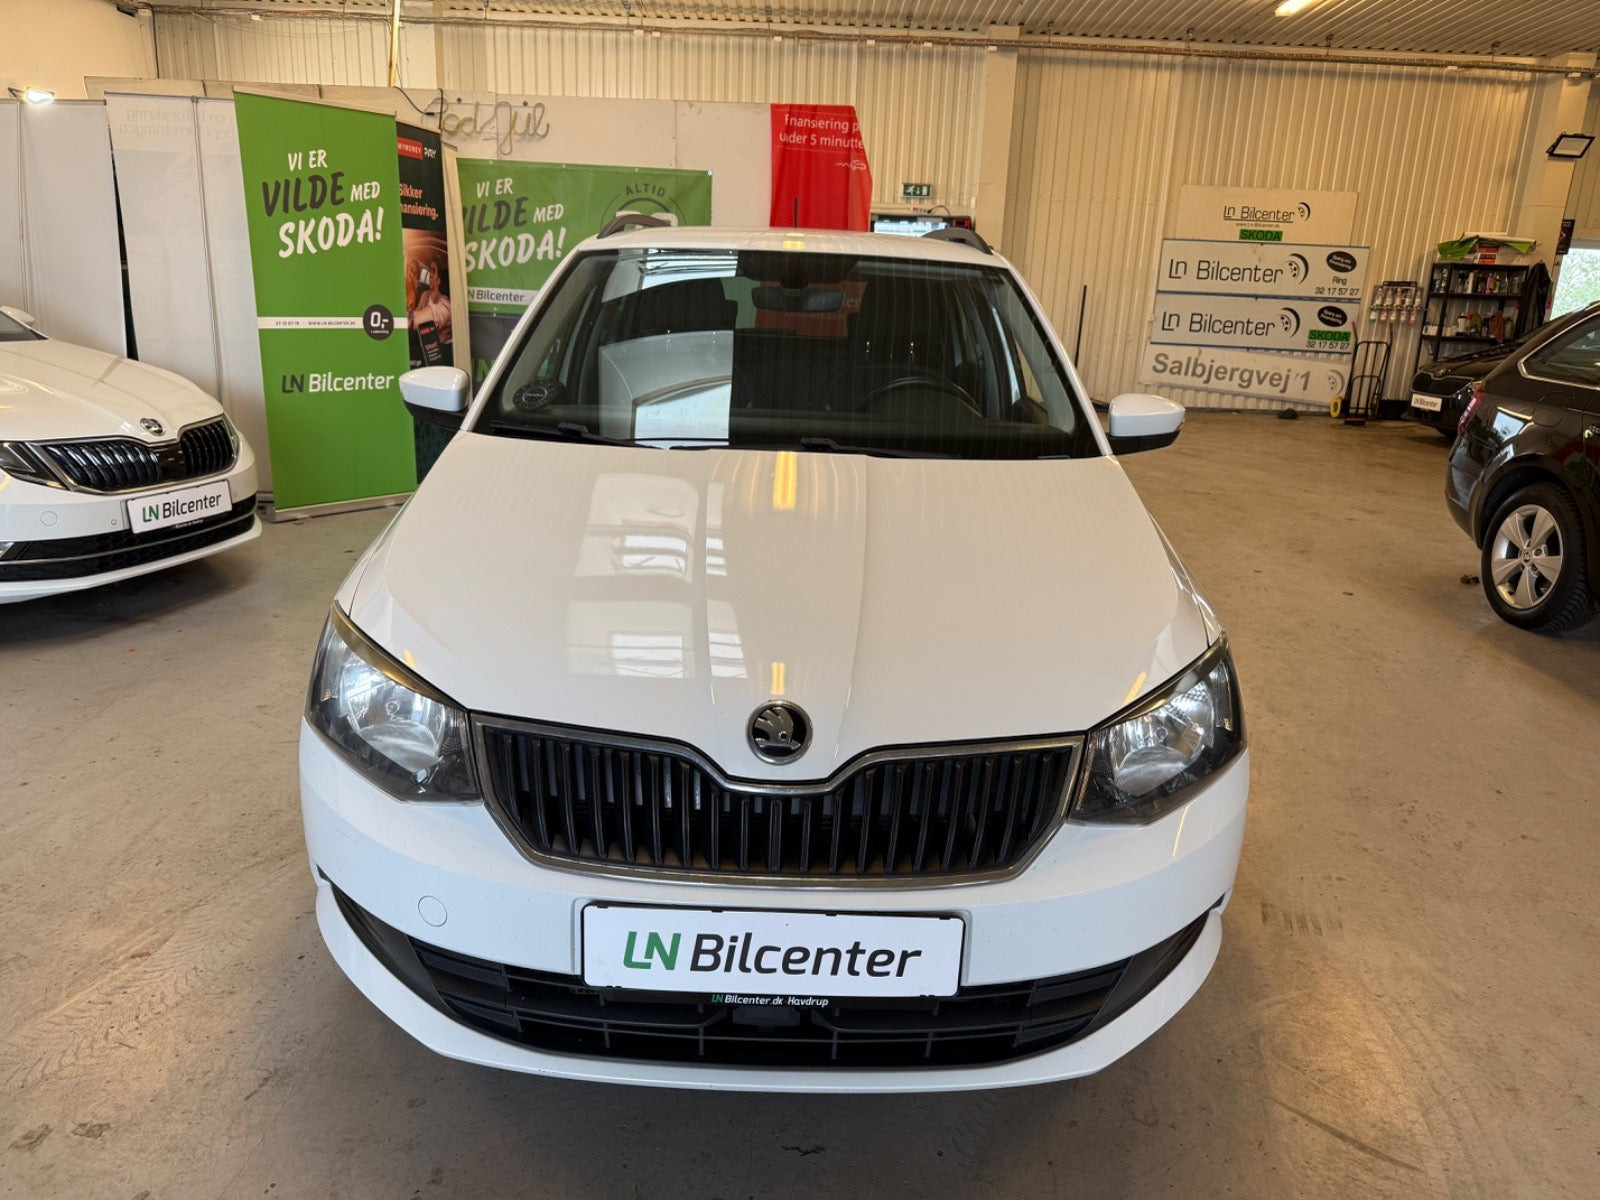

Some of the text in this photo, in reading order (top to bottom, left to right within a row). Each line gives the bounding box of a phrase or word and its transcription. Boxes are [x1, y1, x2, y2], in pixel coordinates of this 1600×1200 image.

[785, 113, 849, 133] Fnansiering
[810, 134, 817, 145] 5
[288, 149, 328, 171] VI ER
[262, 171, 380, 217] VILDE MED
[476, 177, 513, 198] VI ER
[533, 203, 564, 224] MED
[1240, 205, 1295, 221] Bilcenter
[278, 206, 384, 258] SKODA!
[1241, 229, 1282, 241] SKODA
[465, 226, 566, 272] SKODA!
[1168, 259, 1283, 283] Ln Bilcenter
[476, 290, 525, 302] Bilcenter
[1314, 286, 1360, 296] 32 17 57 27
[1161, 311, 1275, 337] Ln Bilcenter
[1306, 340, 1316, 348] 32
[1309, 330, 1349, 341] SKODA
[282, 372, 395, 394] LN Bilcenter
[1152, 353, 1312, 394] Salbjergvej 1
[142, 494, 222, 523] LN Bilcenter
[622, 931, 922, 978] LN Bilcenter
[724, 994, 783, 1005] Bilcenter.dk
[787, 996, 829, 1008] Havdrup
